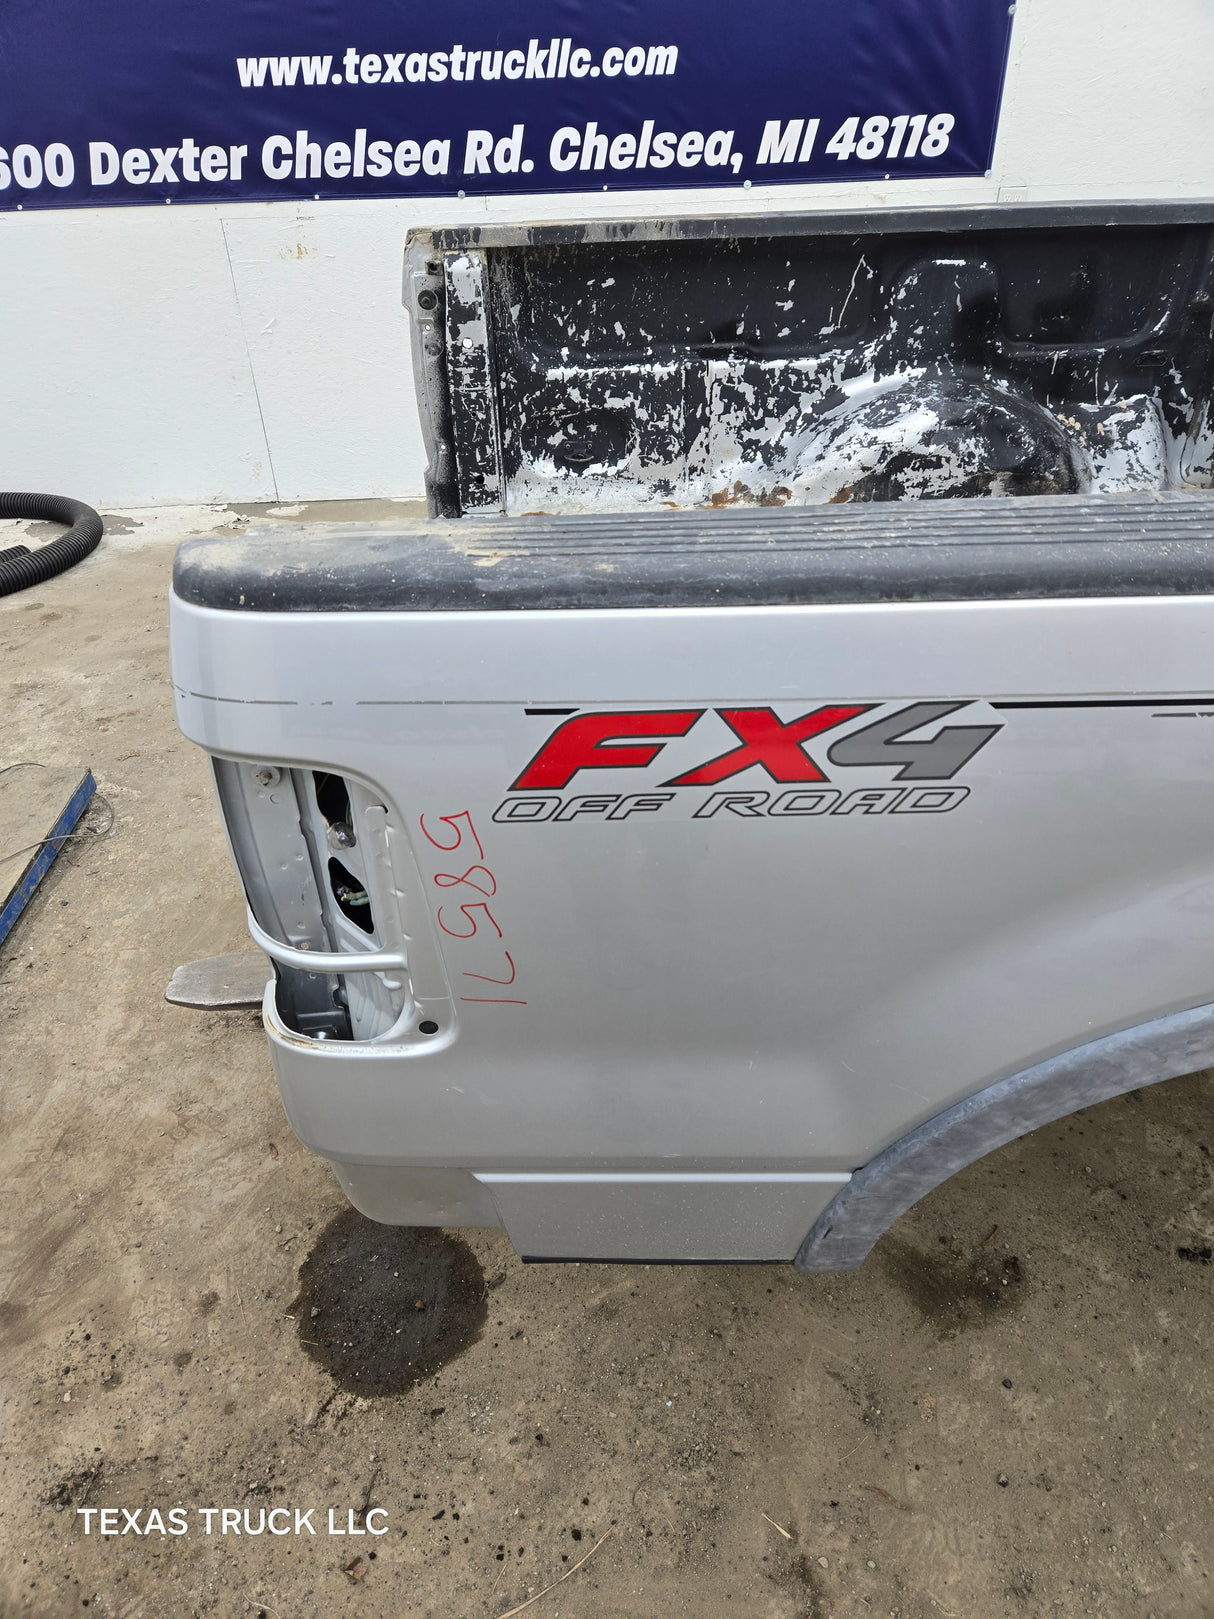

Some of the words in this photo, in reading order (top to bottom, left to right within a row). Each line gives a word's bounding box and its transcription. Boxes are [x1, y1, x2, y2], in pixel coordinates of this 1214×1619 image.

[236, 38, 679, 87] www.texastruckllc.com
[89, 138, 248, 186] Dexter
[261, 128, 451, 180] Chelsea
[463, 124, 535, 175] Rd.
[548, 120, 744, 174] Chelsea,
[755, 118, 821, 164] MI
[825, 113, 956, 162] 48118
[507, 700, 1005, 791] FX4
[492, 793, 676, 823] OFF
[692, 786, 971, 818] ROAD
[419, 810, 528, 1005] 58571
